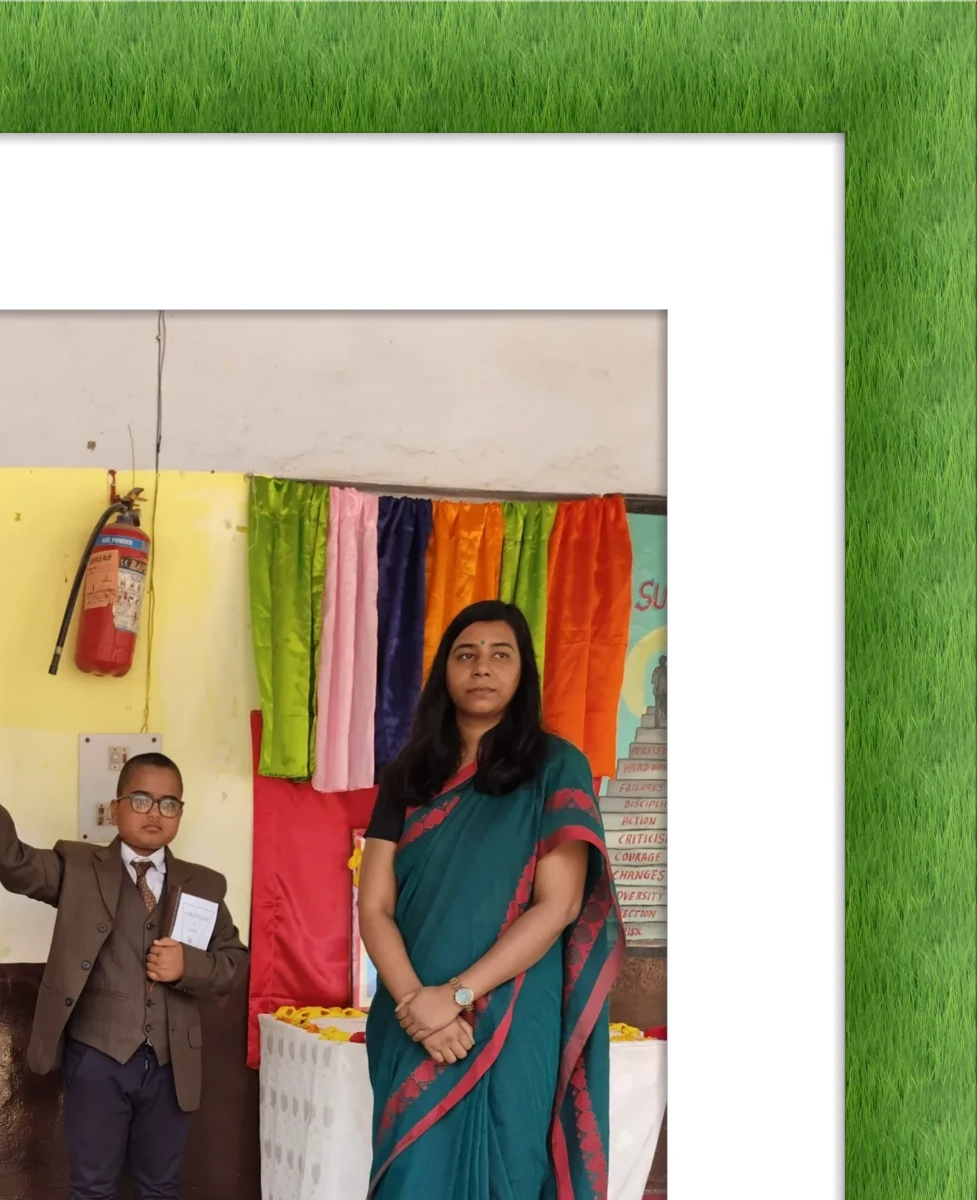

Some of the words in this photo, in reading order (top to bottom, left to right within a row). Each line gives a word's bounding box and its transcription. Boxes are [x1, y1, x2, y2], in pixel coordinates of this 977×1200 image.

[635, 580, 667, 612] SU
[623, 763, 650, 774] HARD
[619, 783, 664, 793] FAILURES
[621, 816, 657, 826] ACTION
[618, 833, 667, 845] CRITICIS
[614, 851, 661, 862] COURAGE
[613, 869, 666, 882] CHANGES
[617, 890, 664, 901] DVERSITY
[621, 909, 657, 919] ECTION
